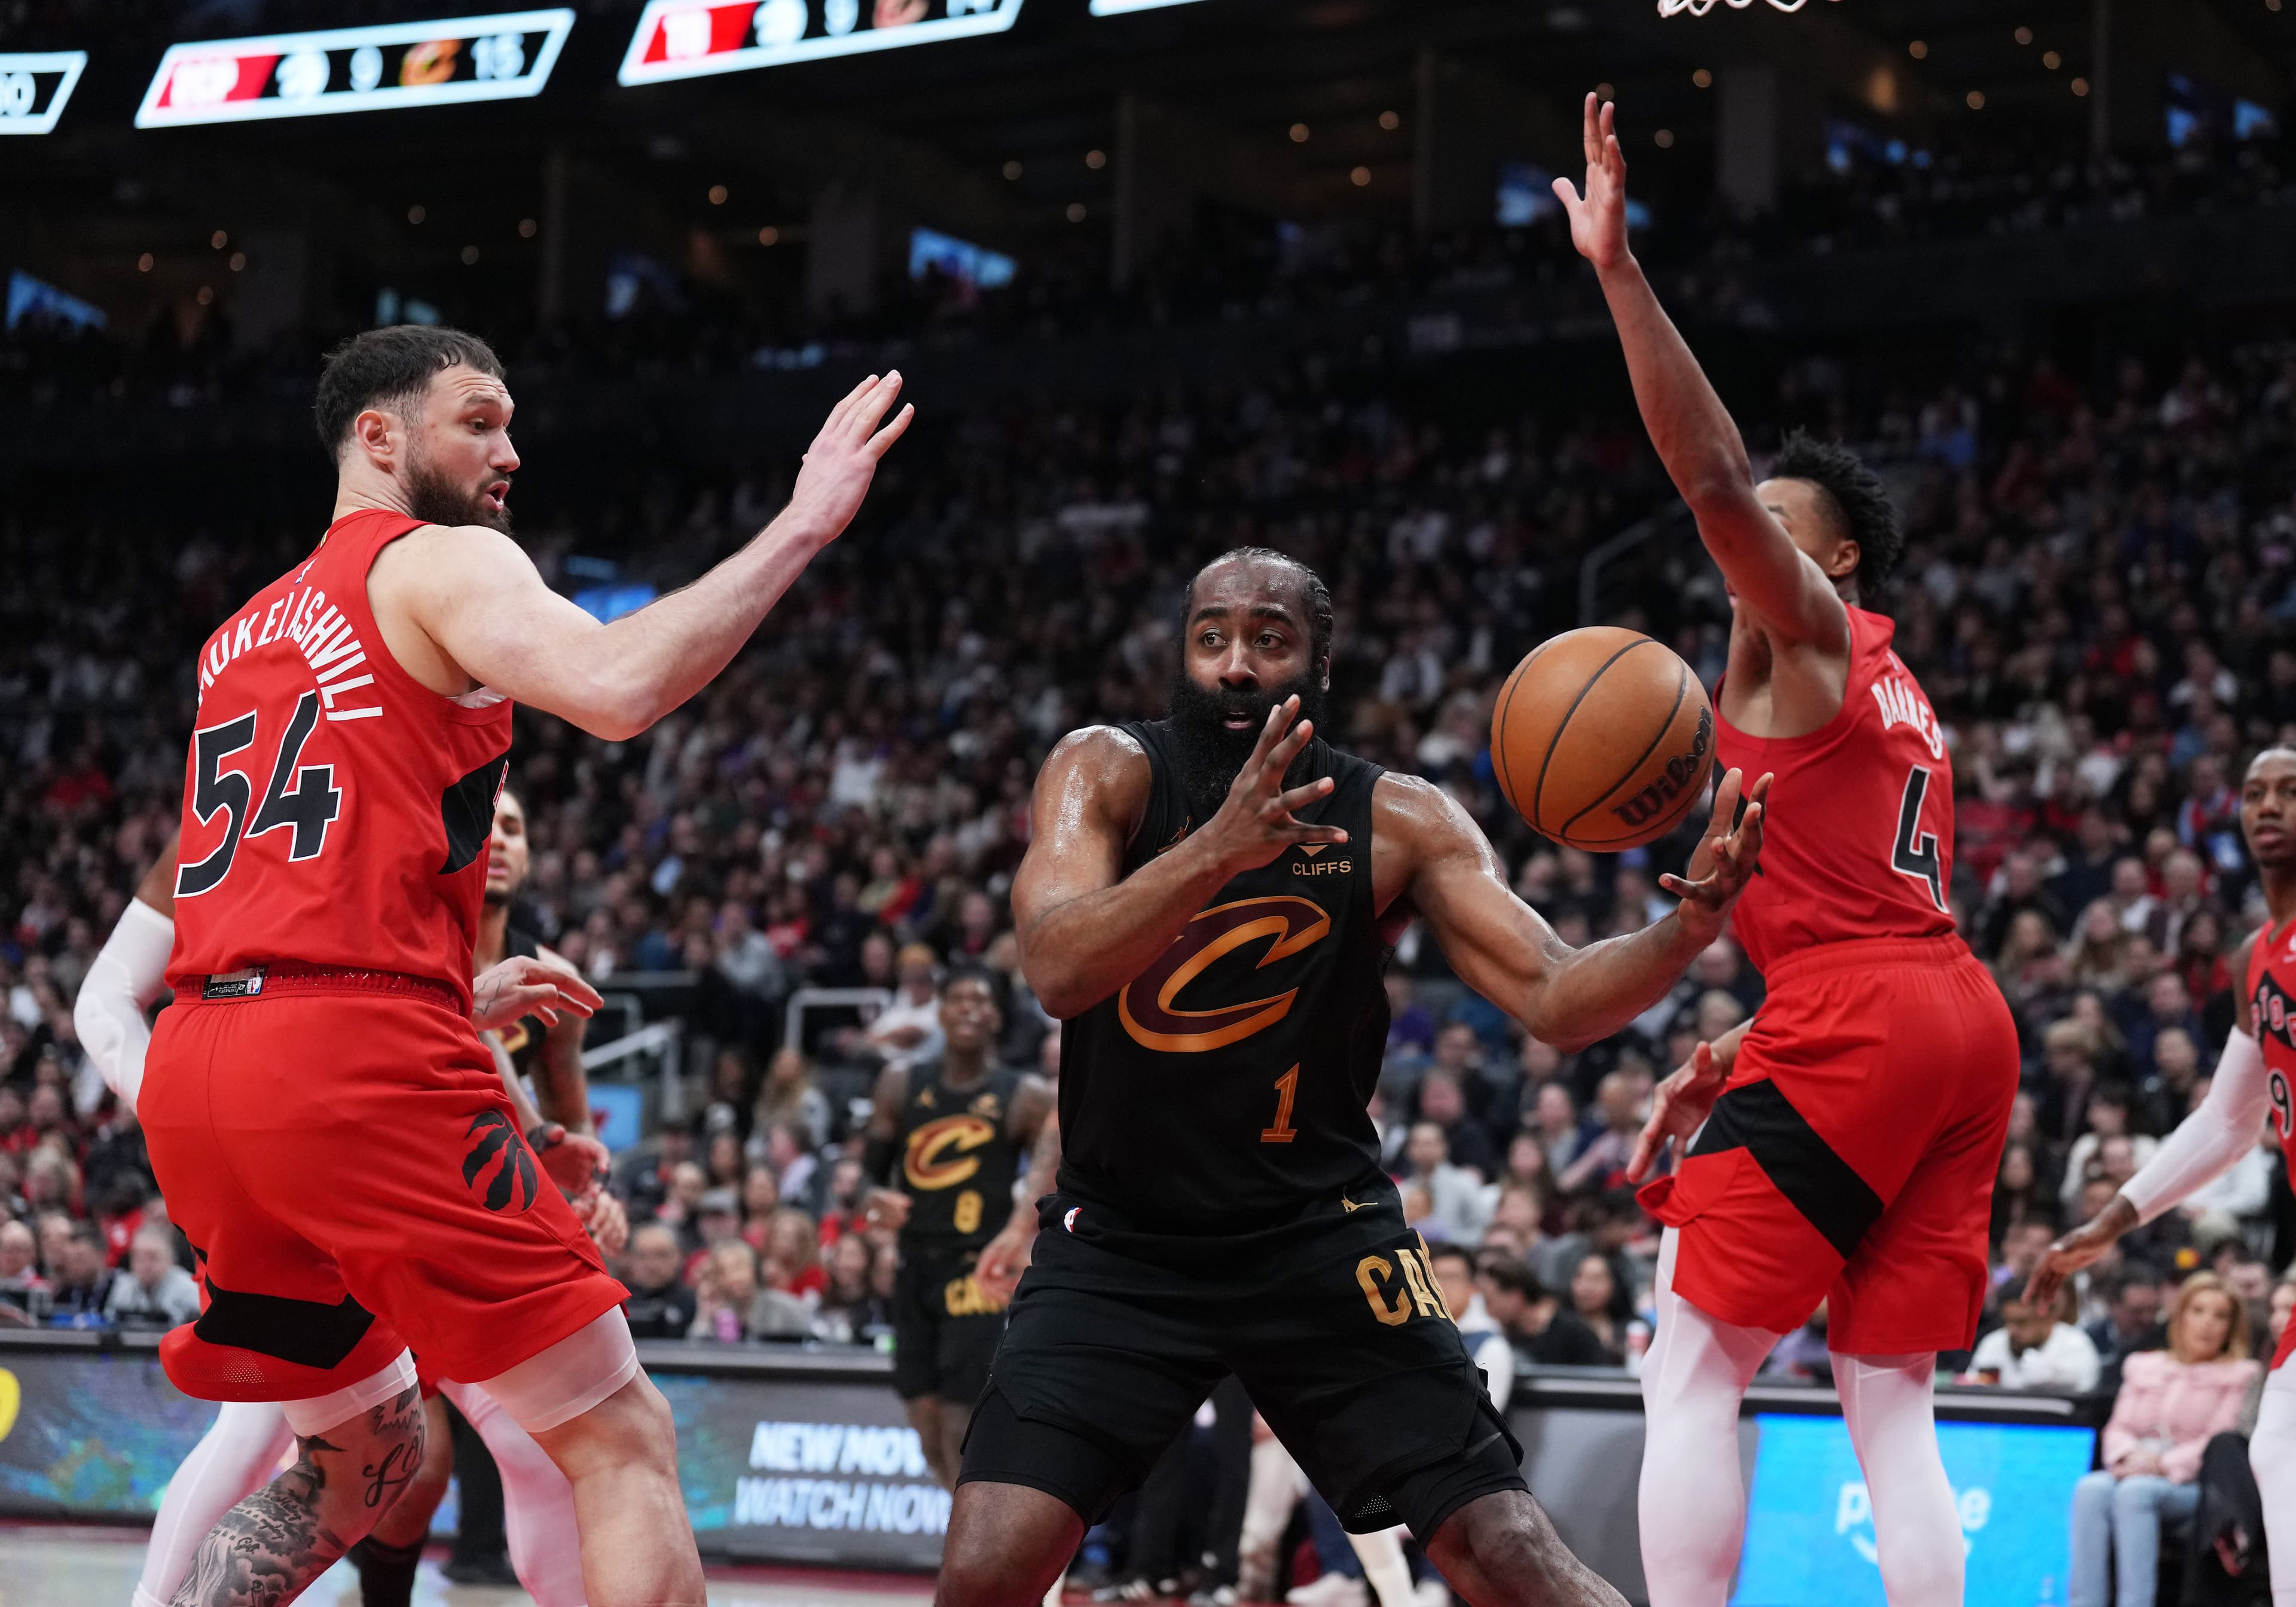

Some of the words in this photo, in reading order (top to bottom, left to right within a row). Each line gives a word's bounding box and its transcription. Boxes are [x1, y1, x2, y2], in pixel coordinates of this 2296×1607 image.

[0, 72, 36, 116] 0
[1871, 676, 1943, 760] BARNES
[174, 689, 342, 898] 54
[1611, 705, 1712, 827] Wilson
[1292, 860, 1352, 876] CLIFFS
[1891, 764, 1950, 915] 4
[1260, 1062, 1299, 1143] 1
[2268, 1068, 2293, 1139] 9
[749, 1420, 844, 1472] NEW
[735, 1475, 867, 1531] WATCH
[865, 1483, 954, 1535] NOW
